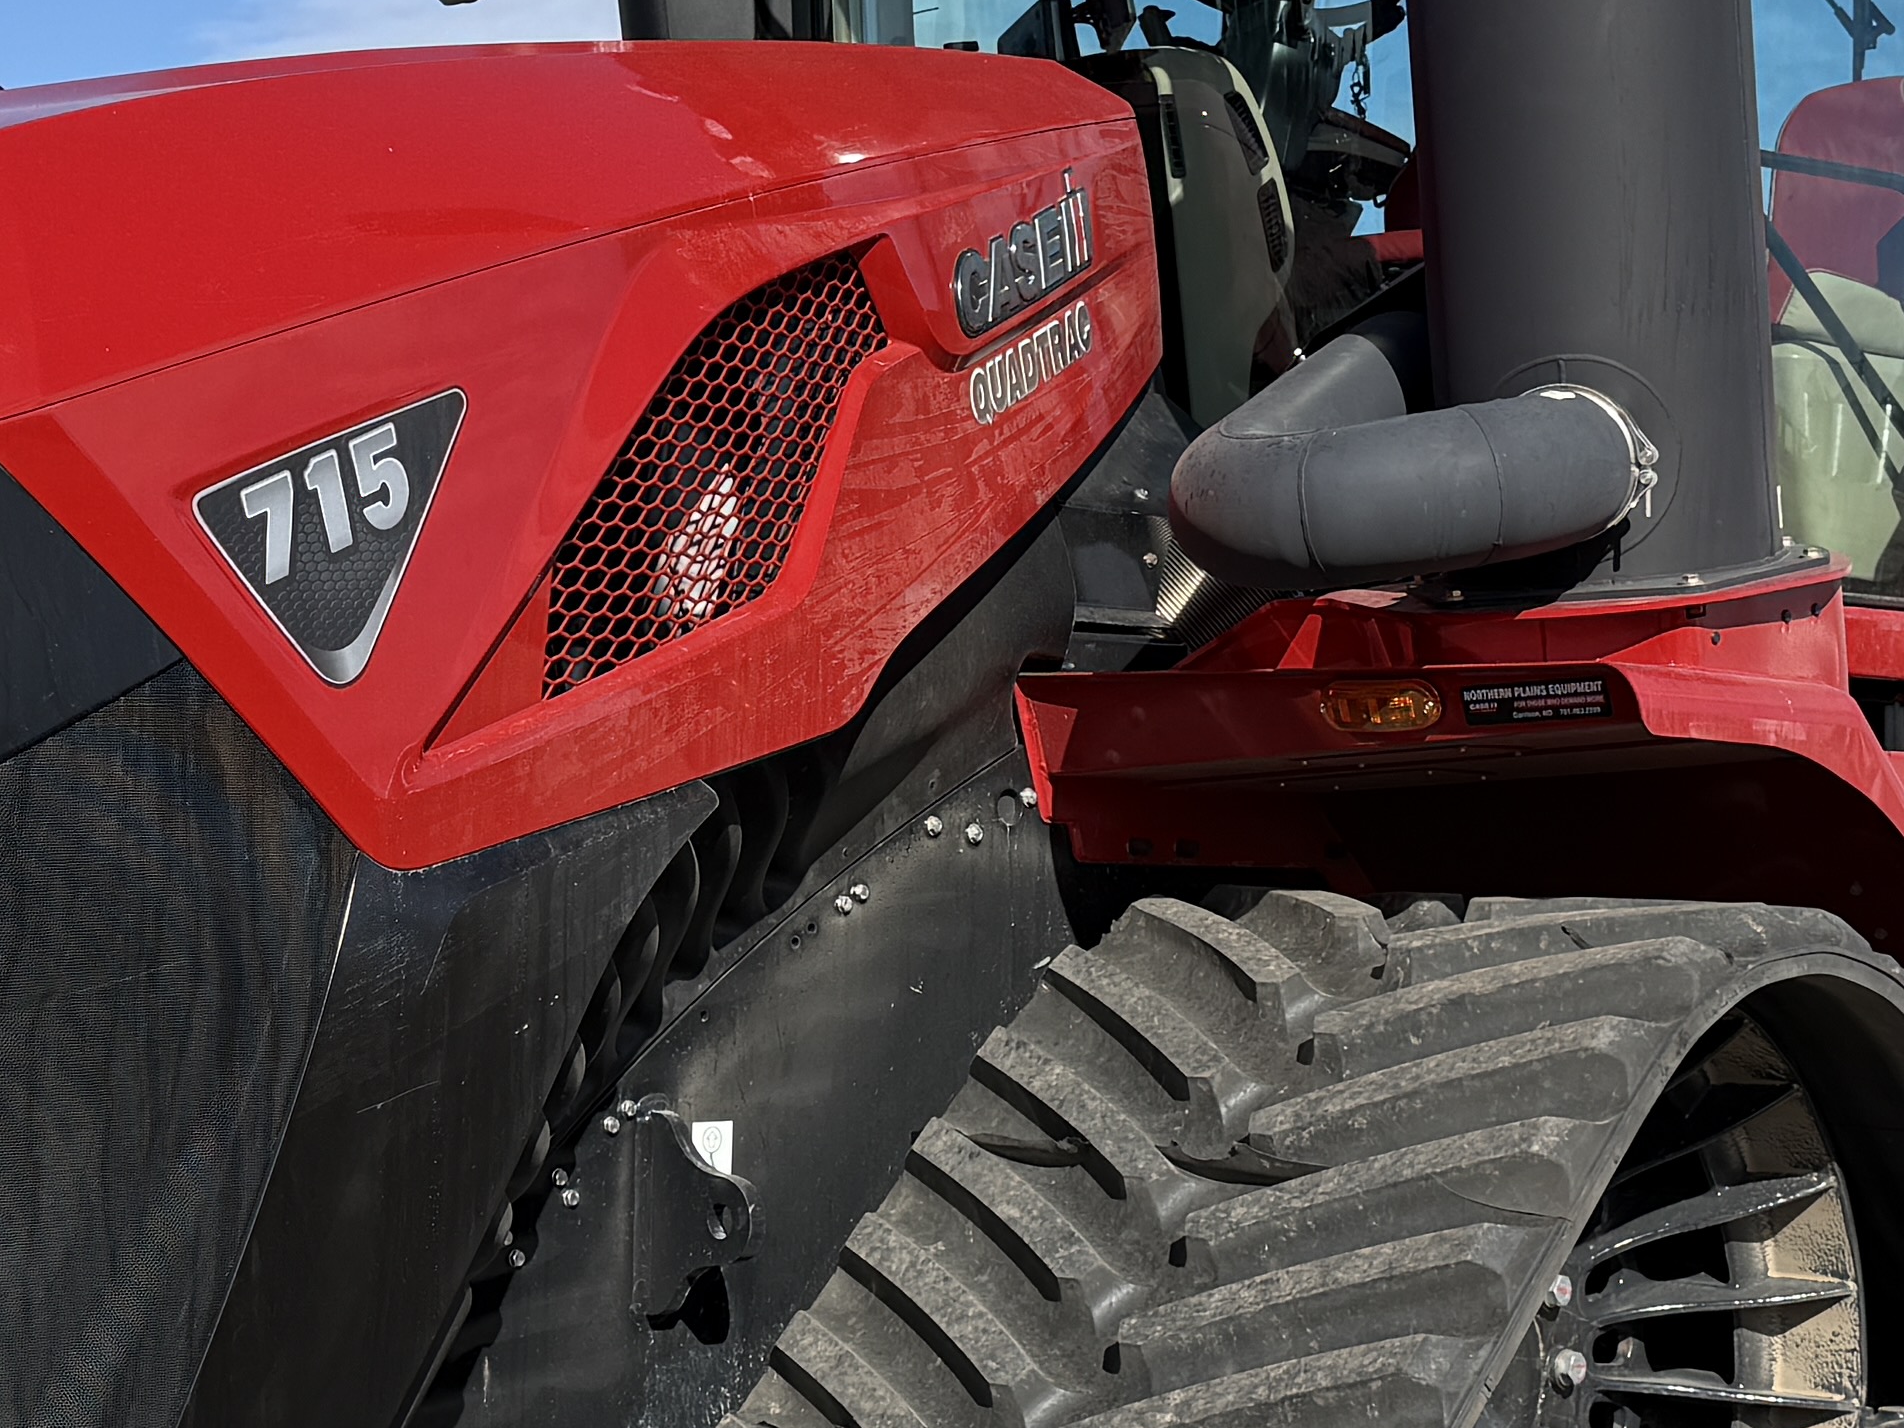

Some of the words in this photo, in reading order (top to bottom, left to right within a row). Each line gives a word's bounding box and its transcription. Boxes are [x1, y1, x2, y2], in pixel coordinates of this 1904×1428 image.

[954, 204, 1064, 335] CASE
[969, 300, 1092, 426] QUADTRAC
[240, 421, 410, 585] 715
[1463, 687, 1512, 701] NORTHERN
[1514, 684, 1547, 698] PLAINS
[1548, 681, 1603, 695] EQUIPMENT
